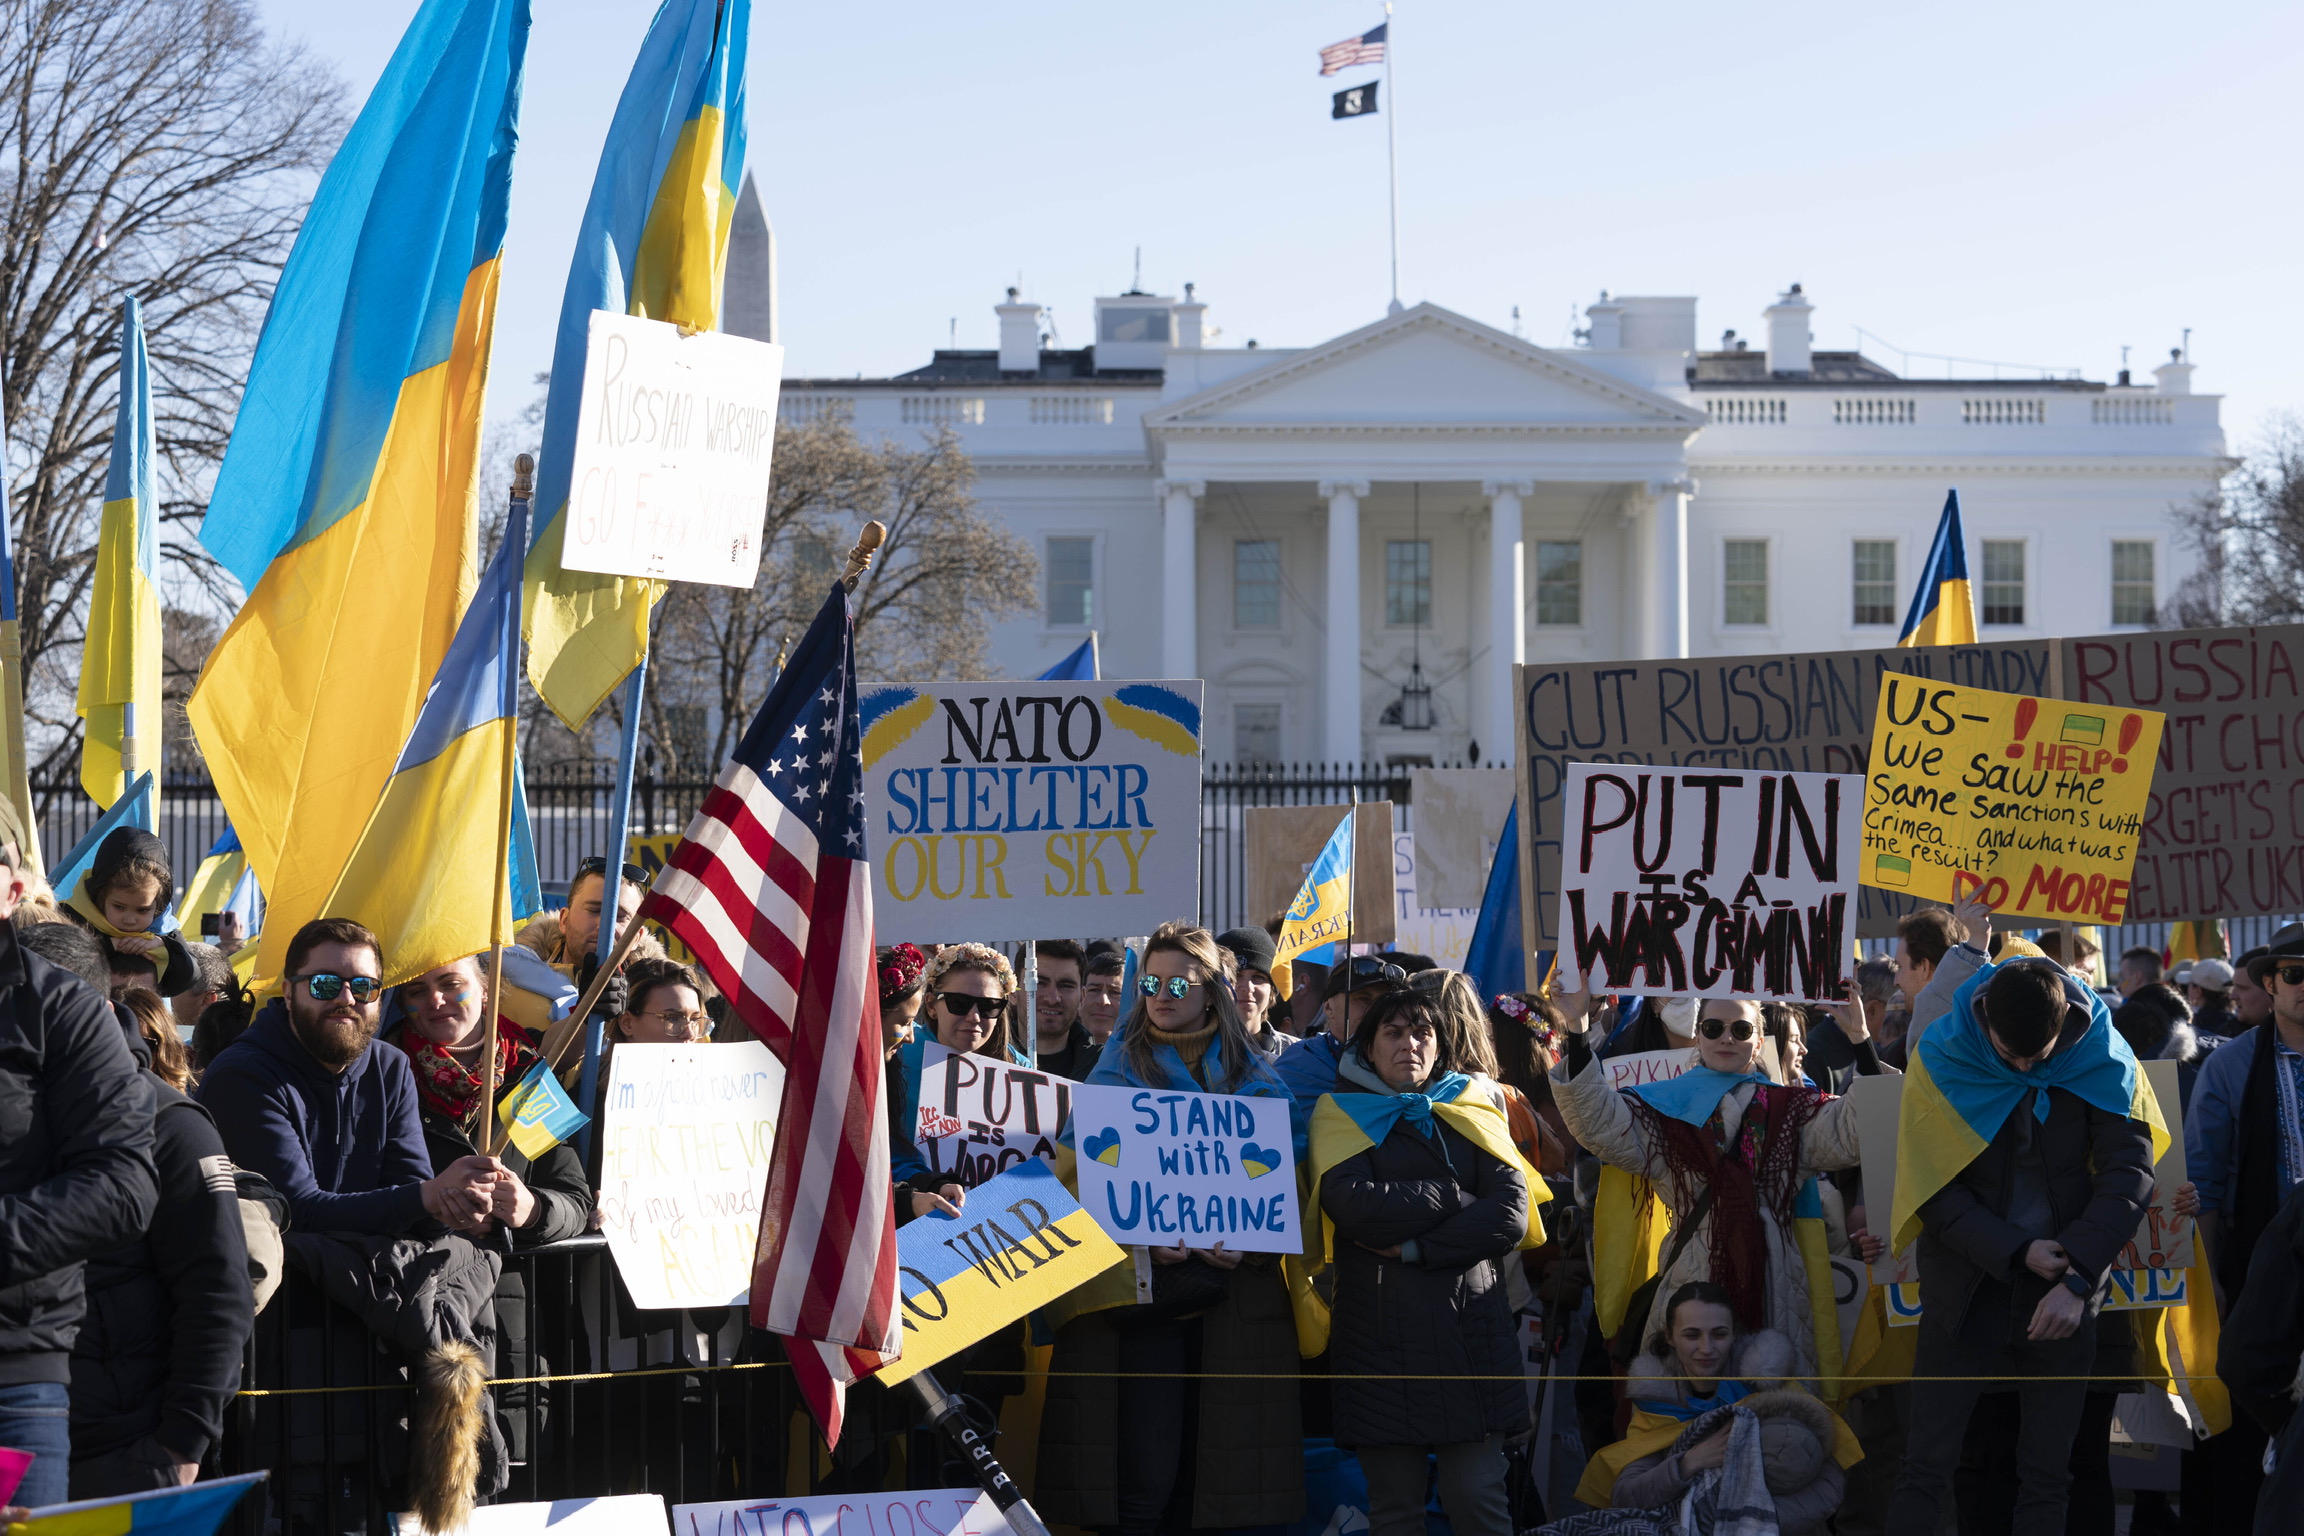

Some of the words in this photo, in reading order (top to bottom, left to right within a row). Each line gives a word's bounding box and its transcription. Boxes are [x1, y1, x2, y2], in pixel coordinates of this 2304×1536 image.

[705, 397, 769, 466] WARSHIP
[577, 466, 617, 546] GO
[939, 695, 1102, 764] NATO
[1529, 667, 1638, 750] CUT
[2219, 708, 2304, 774] CH
[886, 763, 1154, 835] SHELTER
[2055, 768, 2105, 805] the
[1579, 772, 1841, 883] PUTIN
[1864, 833, 1902, 854] the
[1910, 842, 2000, 873] result?
[1976, 826, 2015, 850] and
[2018, 829, 2076, 856] what
[2080, 837, 2127, 861] was
[2099, 812, 2142, 838] with
[884, 832, 1013, 903] OUR
[1044, 829, 1158, 898] SKY
[1634, 868, 1710, 906] IS
[1733, 870, 1768, 907] A
[1951, 869, 2010, 911] DO
[2015, 862, 2131, 923] MORE
[1565, 887, 1688, 993] WAR
[711, 1070, 768, 1102] never
[918, 1106, 941, 1126] ICC
[943, 1053, 1071, 1142] PUTI
[1131, 1091, 1256, 1140] STAND
[604, 1123, 672, 1180] HEAR
[668, 1121, 733, 1176] THE
[735, 1119, 778, 1169] VO
[938, 1114, 963, 1135] NOW
[967, 1119, 1006, 1148] IS
[645, 1195, 685, 1239] my
[693, 1170, 761, 1220] loved
[899, 1265, 949, 1334] O
[943, 1197, 1083, 1289] WAR
[961, 1428, 1012, 1490] BIRD
